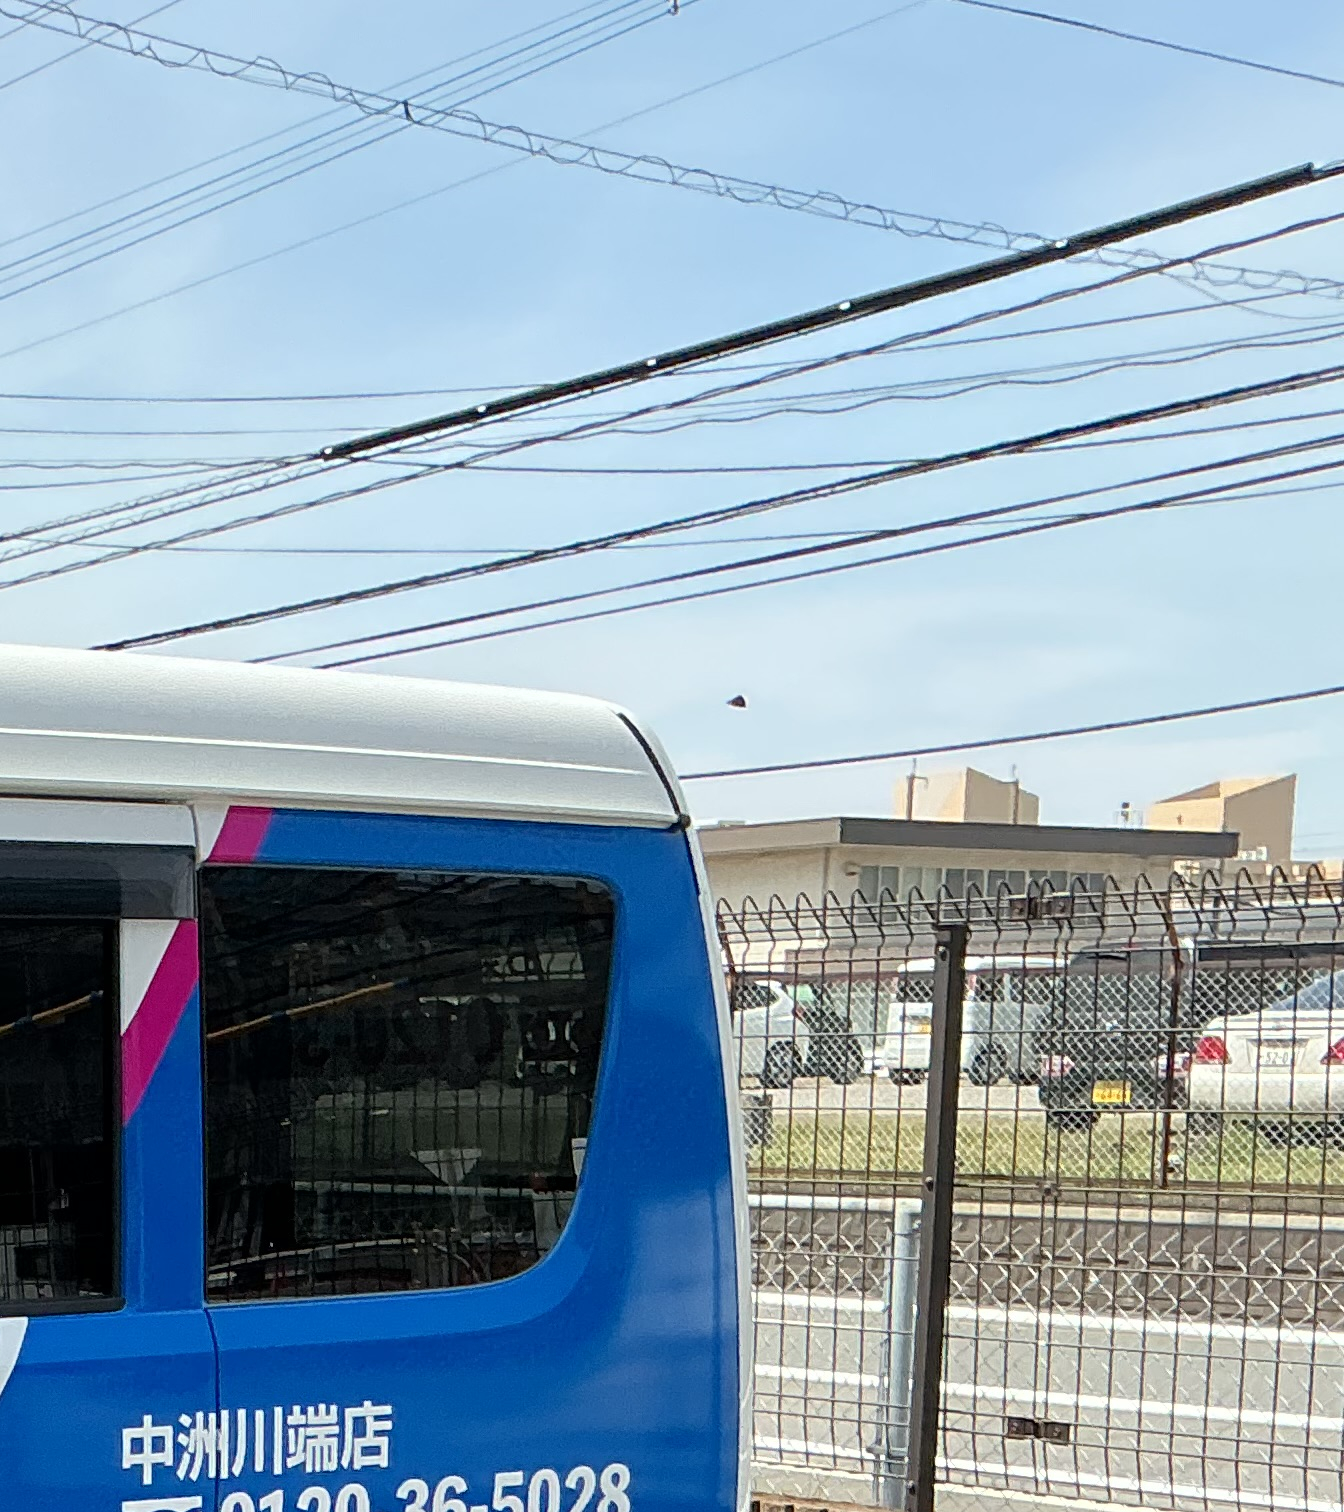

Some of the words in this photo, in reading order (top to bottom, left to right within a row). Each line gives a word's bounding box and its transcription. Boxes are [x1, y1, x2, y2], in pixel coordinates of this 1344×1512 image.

[121, 1400, 393, 1486] 中洲川端店
